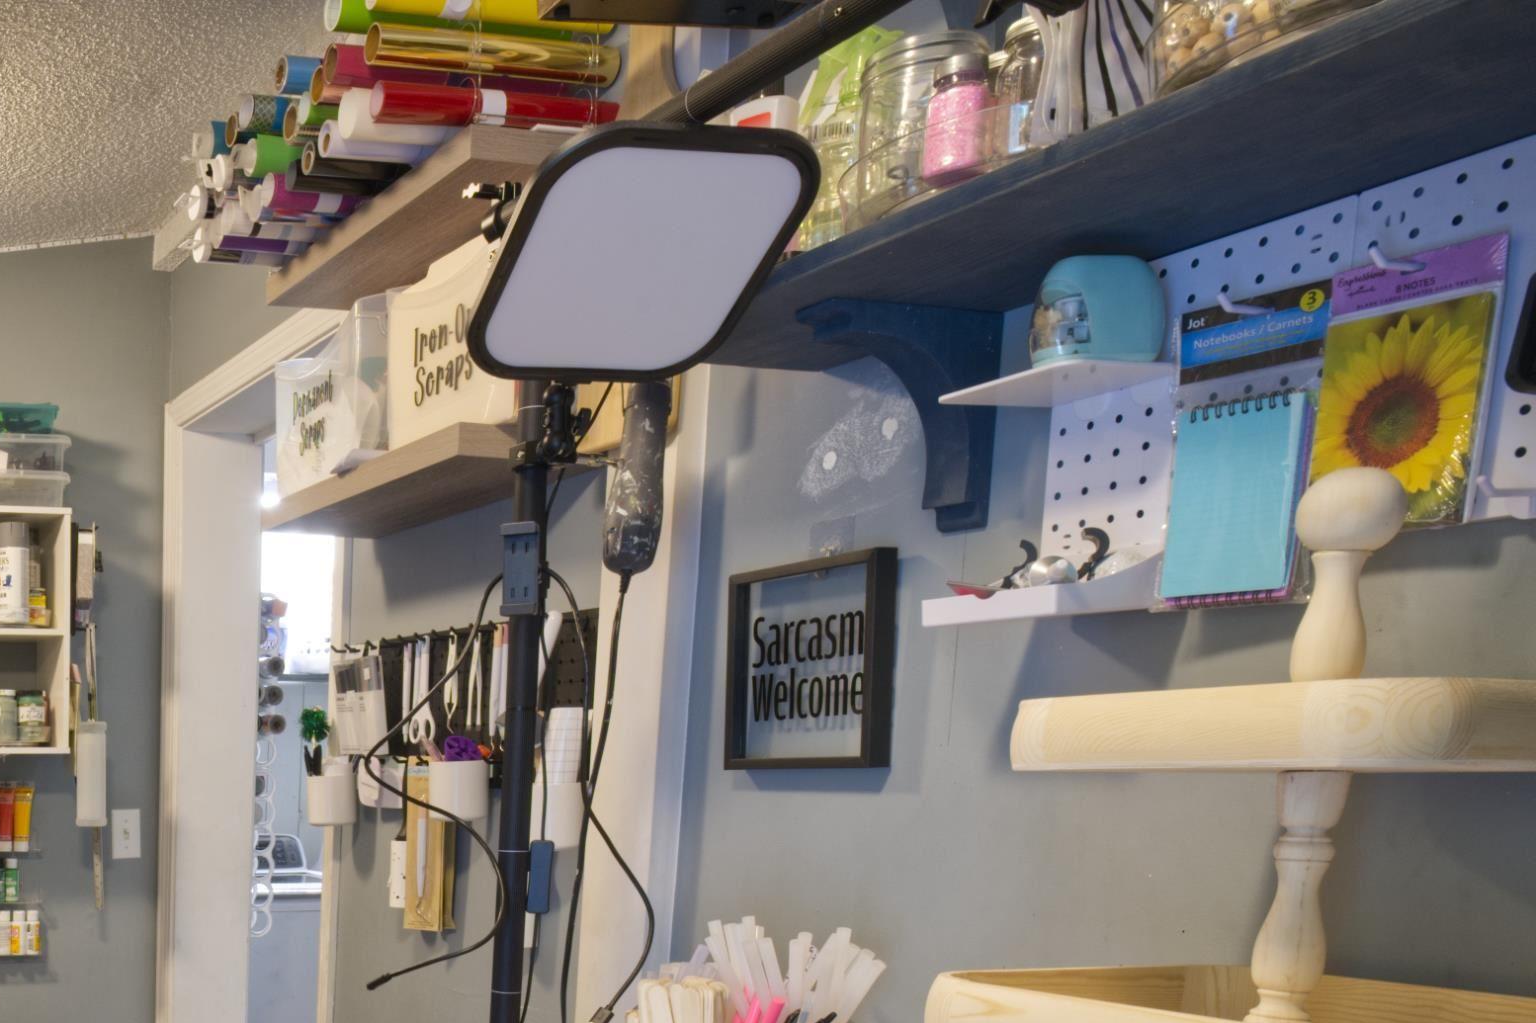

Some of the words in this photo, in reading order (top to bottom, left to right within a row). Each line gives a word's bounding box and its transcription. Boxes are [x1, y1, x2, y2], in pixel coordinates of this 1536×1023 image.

[1306, 290, 1317, 306] 3
[1402, 276, 1436, 292] NOTES
[1187, 317, 1206, 330] Jot
[1193, 327, 1256, 350] Notebooks
[1267, 314, 1313, 333] Carnets
[413, 352, 473, 407] Scraps
[752, 609, 864, 668] Sarcasm
[751, 667, 864, 723] Welcome
